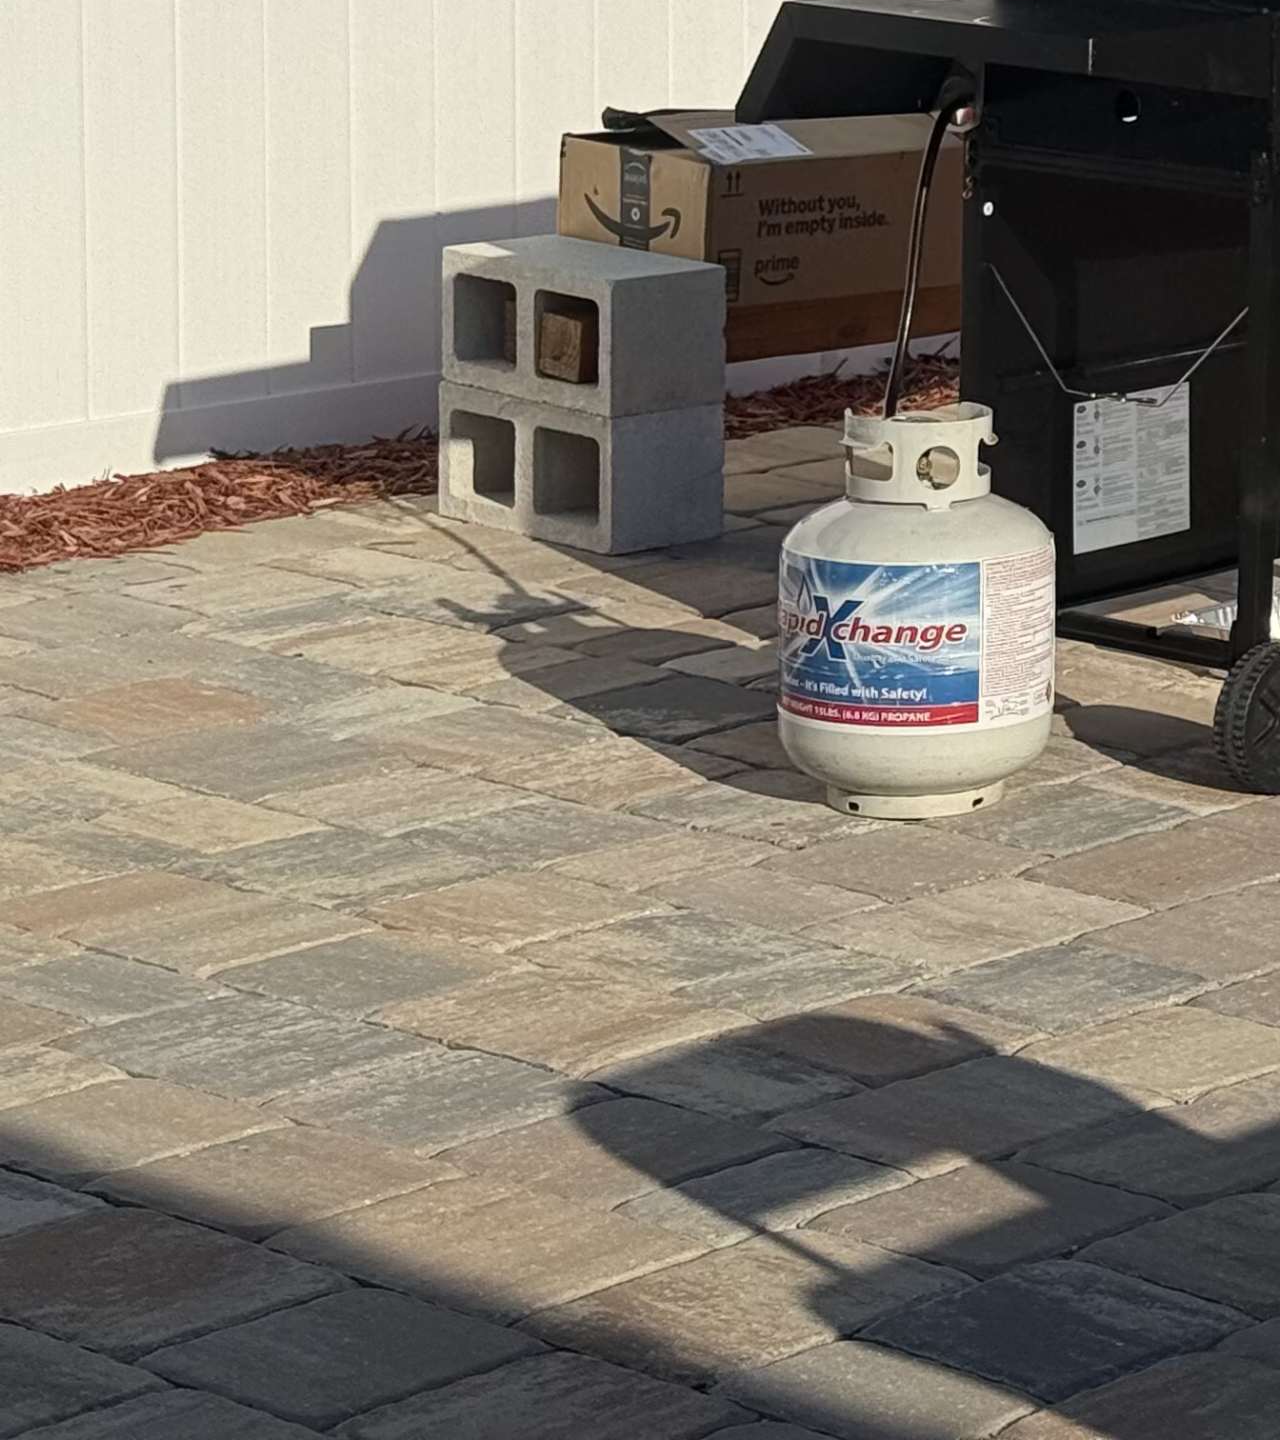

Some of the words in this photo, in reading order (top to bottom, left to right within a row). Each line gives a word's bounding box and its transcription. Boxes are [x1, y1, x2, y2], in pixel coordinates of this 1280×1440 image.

[759, 195, 824, 216] Without
[827, 194, 860, 214] you,
[757, 220, 782, 238] I'm
[785, 215, 836, 236] empty
[839, 211, 889, 230] inside.
[754, 255, 799, 278] prime
[820, 682, 848, 696] Filled
[851, 686, 879, 699] with
